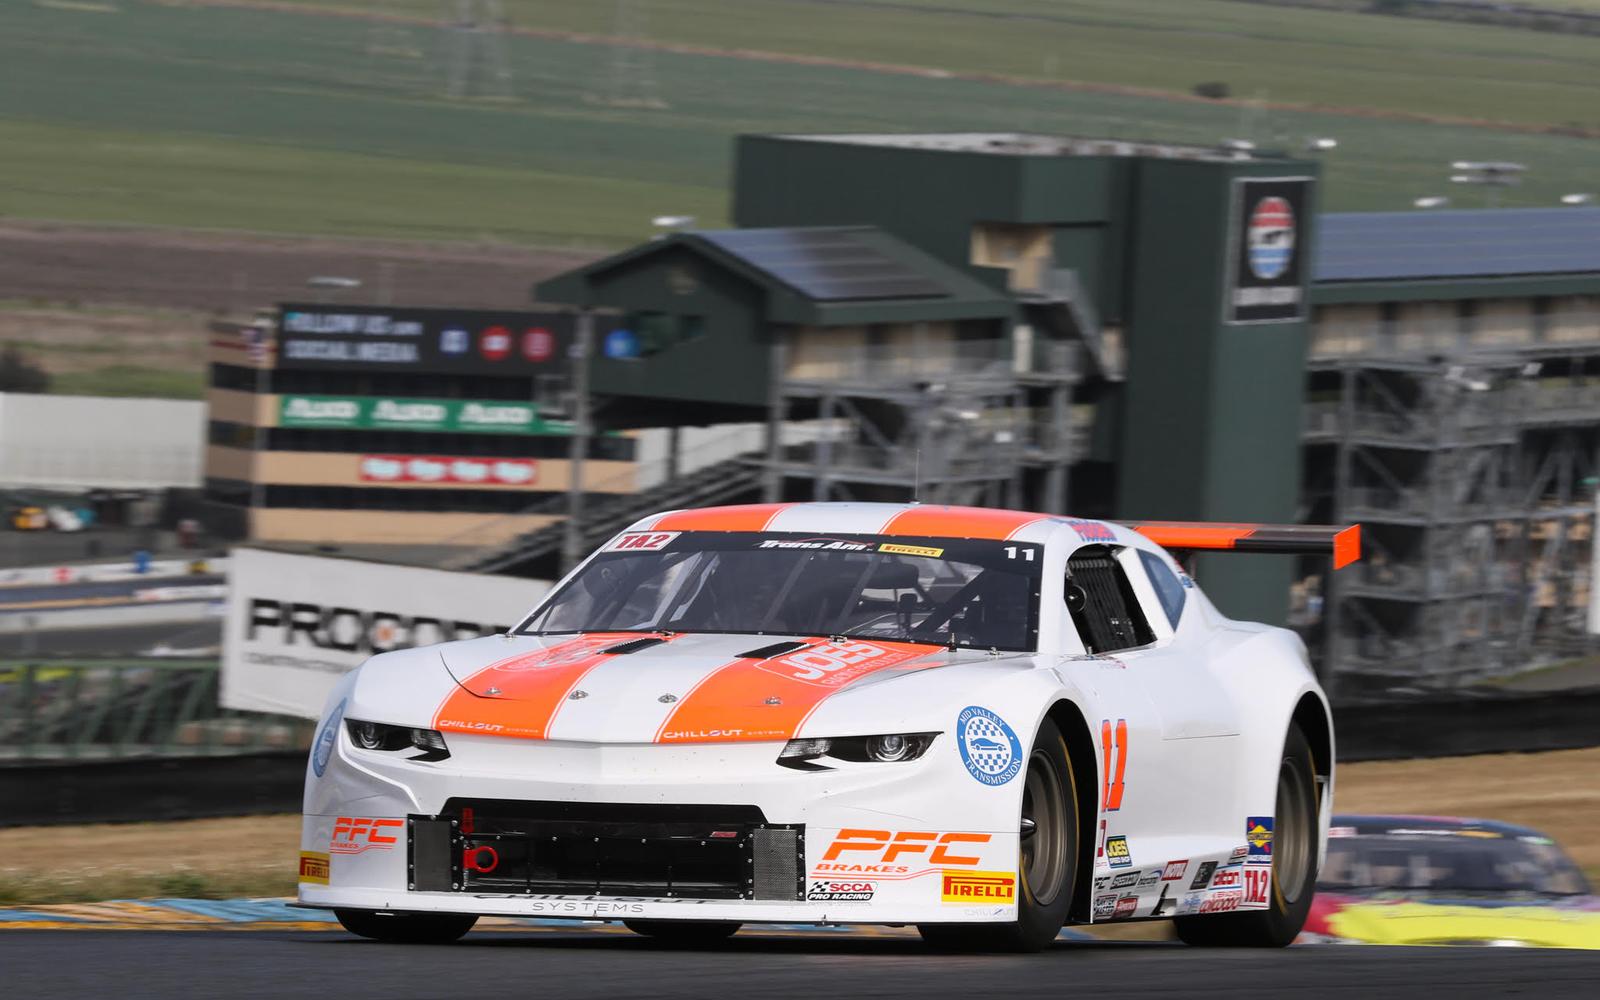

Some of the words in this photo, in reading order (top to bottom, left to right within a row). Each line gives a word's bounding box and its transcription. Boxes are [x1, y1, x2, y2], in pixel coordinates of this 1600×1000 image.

[615, 535, 670, 548] TA2
[759, 540, 824, 549] Trans
[820, 541, 866, 551] Am
[1003, 546, 1034, 562] 11
[247, 599, 511, 655] PROCO
[779, 640, 886, 680] JOES
[971, 707, 1005, 727] VALLEY
[439, 719, 504, 732] CHILLOUT
[663, 729, 743, 738] CHILLOUT
[965, 757, 1021, 785] TRANSMISSION
[333, 817, 404, 844] PFC
[822, 828, 992, 866] PFC
[815, 863, 909, 874] BRAKES
[829, 883, 874, 892] SCCA
[943, 875, 1015, 898] PIRELLI
[1244, 870, 1269, 903] TA2
[810, 892, 835, 901] PRO
[837, 892, 872, 901] RACING
[531, 902, 645, 913] SYSTEMS
